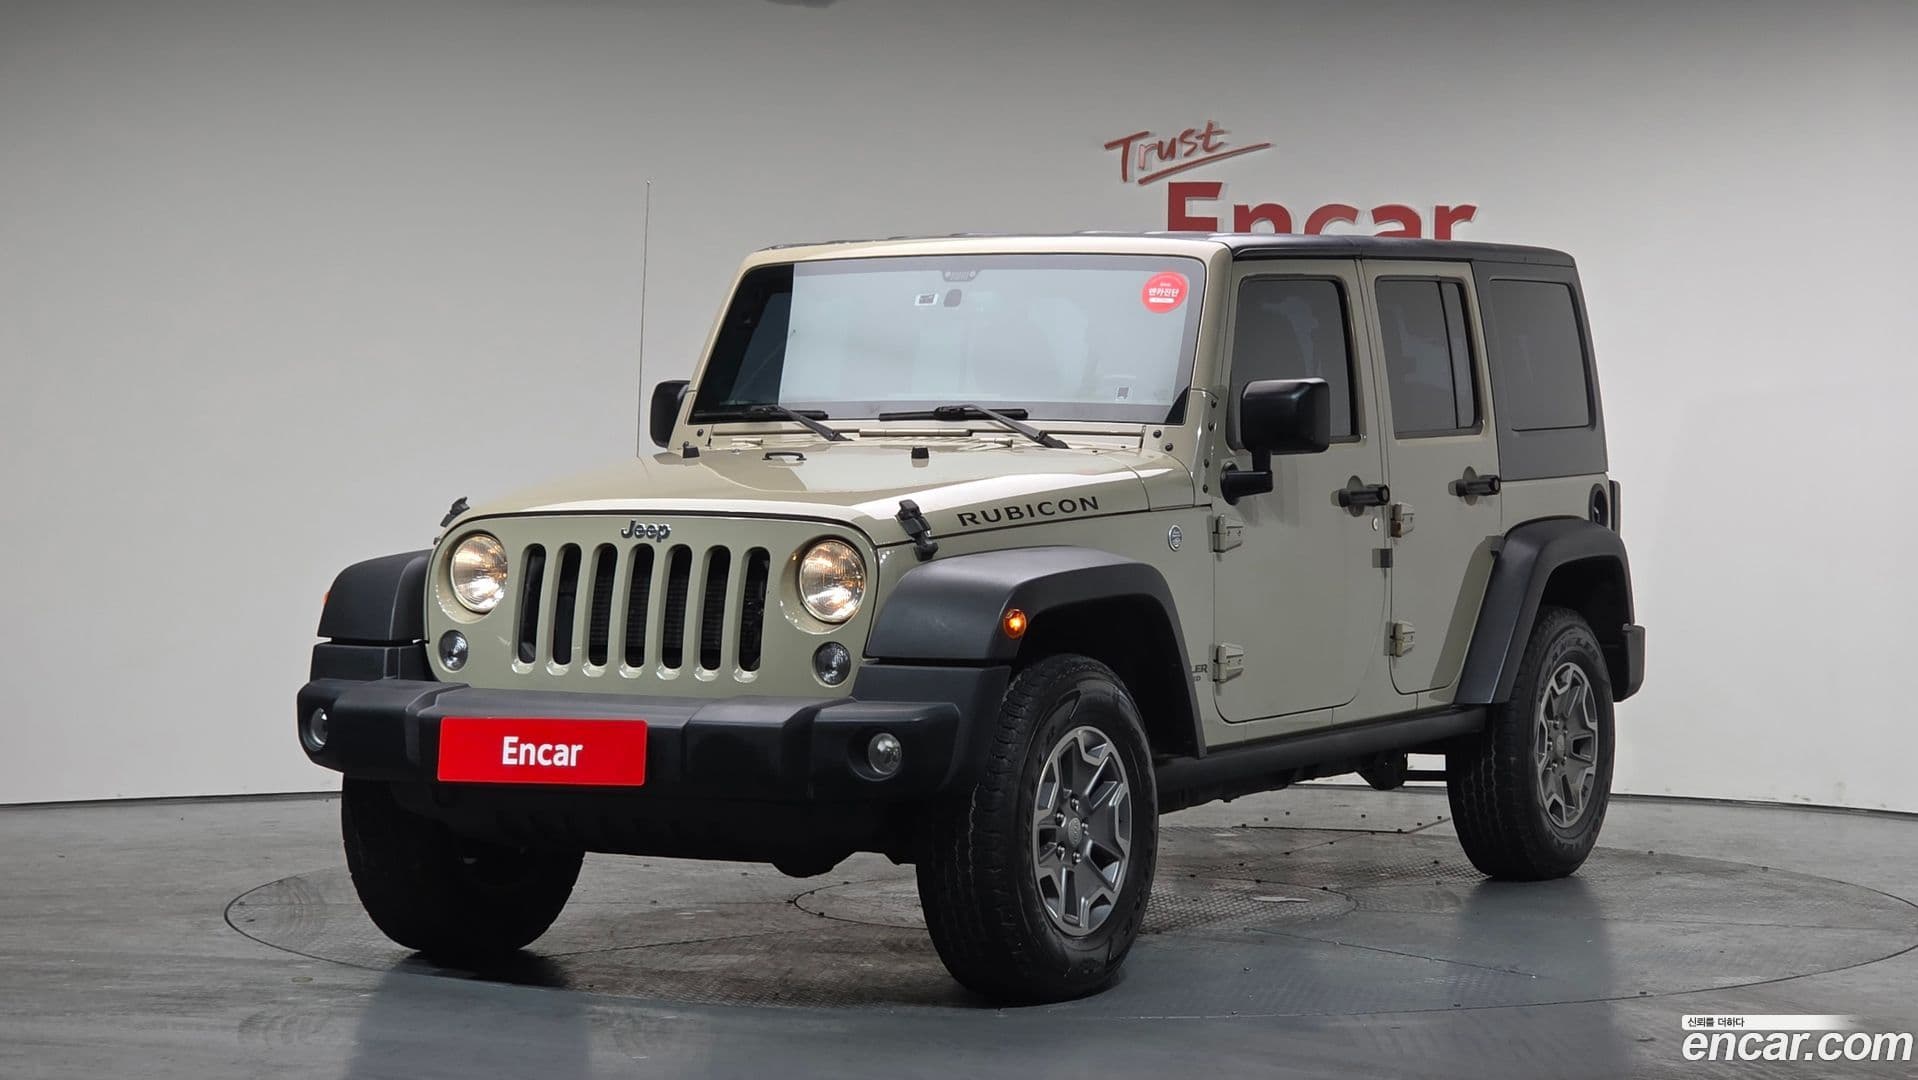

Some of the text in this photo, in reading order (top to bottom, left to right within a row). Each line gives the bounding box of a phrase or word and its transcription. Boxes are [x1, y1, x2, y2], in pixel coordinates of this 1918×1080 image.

[1104, 120, 1225, 183] Trust
[957, 496, 1099, 527] RUBICON
[621, 519, 671, 543] Jeep
[502, 736, 583, 767] Encar
